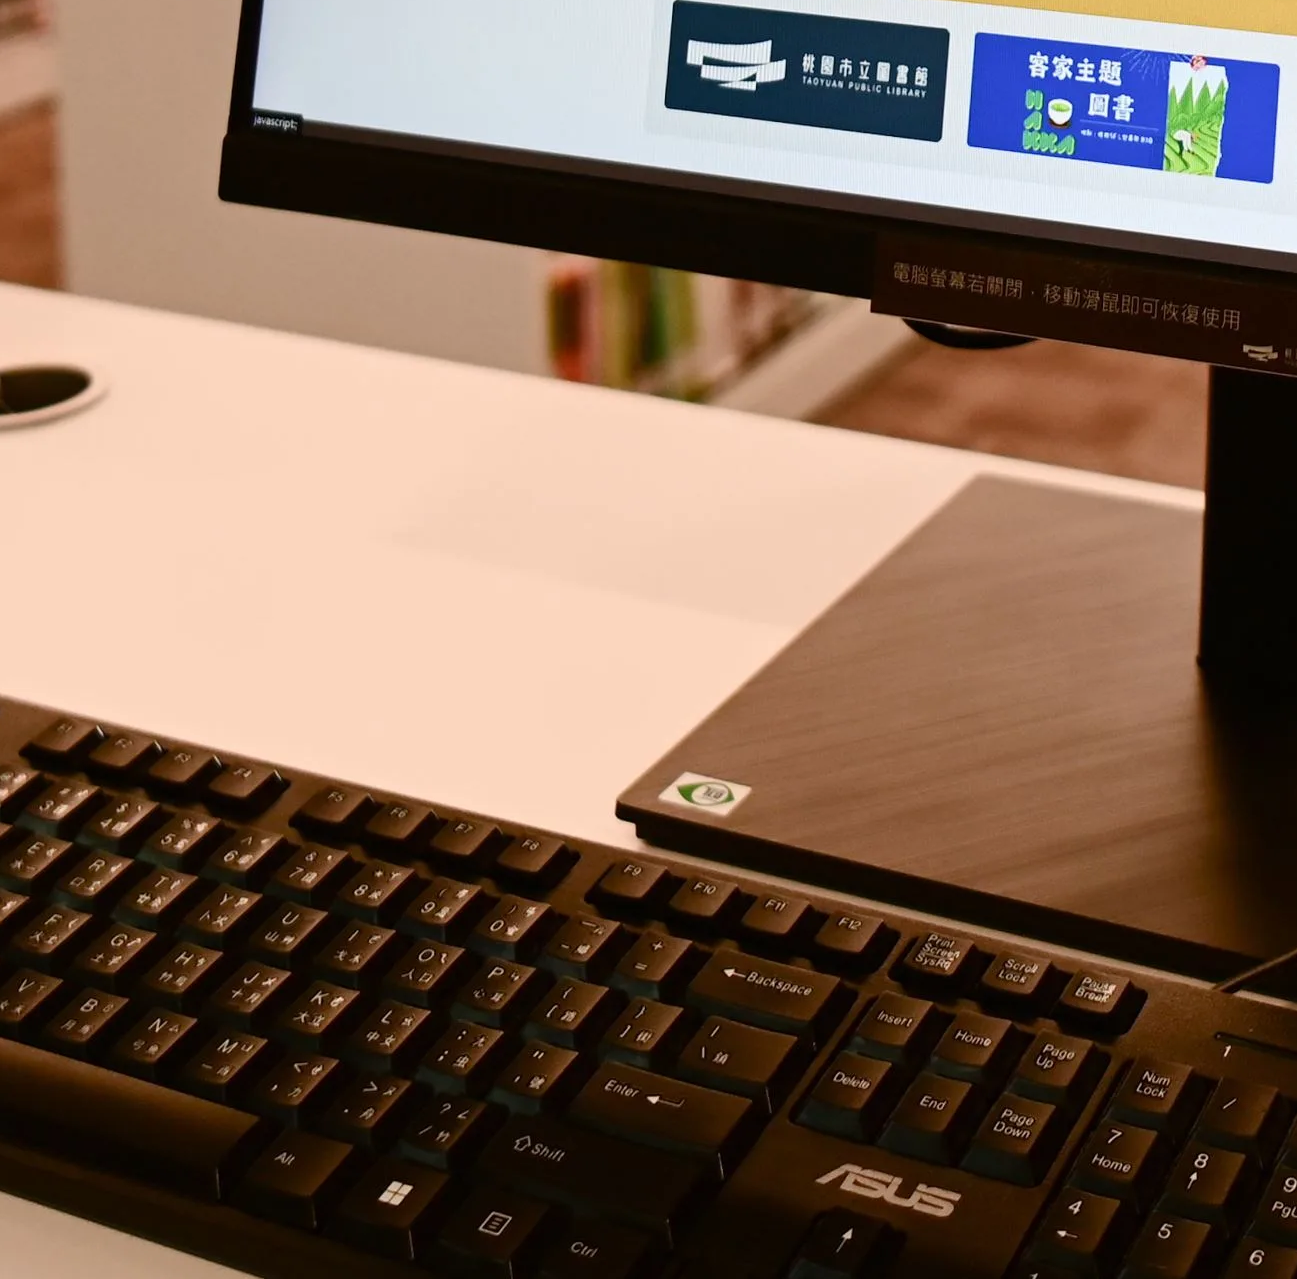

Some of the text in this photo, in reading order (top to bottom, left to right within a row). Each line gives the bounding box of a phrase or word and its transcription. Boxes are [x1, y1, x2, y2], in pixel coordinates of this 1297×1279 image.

[1028, 51, 1123, 87] 客家主題
[803, 76, 927, 98] TAOYUAN PUBLIC LIBRARY
[1088, 92, 1135, 122] 圖書
[327, 791, 345, 803] F5
[390, 806, 408, 819] F6
[455, 822, 473, 835] F7
[160, 833, 176, 846] 5
[521, 838, 540, 852] F8
[26, 841, 45, 855] E
[223, 849, 239, 864] 6
[88, 858, 107, 872] R
[289, 866, 305, 879] 7
[623, 864, 642, 877] F9
[155, 875, 171, 888] T
[693, 881, 717, 896] F10
[353, 884, 369, 897] 8
[219, 892, 235, 906] Y
[765, 898, 787, 913] F11
[420, 901, 436, 914] 9
[44, 913, 63, 926] F
[281, 911, 300, 926] U
[489, 919, 505, 932] 0
[838, 916, 862, 931] F12
[110, 933, 129, 947] G
[651, 940, 665, 952] +
[927, 933, 956, 949] Print
[174, 951, 195, 966] H
[634, 962, 648, 971] =
[915, 952, 953, 971] SysRq
[1004, 958, 1039, 975] Scroll
[243, 971, 261, 986] J
[487, 966, 505, 980] P
[998, 969, 1027, 984] Lock
[17, 977, 36, 994] V
[745, 971, 814, 997] Backspace
[1081, 977, 1117, 993] Pause
[309, 989, 329, 1006] K
[1075, 987, 1111, 1004] Break
[80, 996, 99, 1014] B
[380, 1009, 393, 1025] L
[877, 1010, 914, 1028] Insert
[147, 1017, 169, 1034] N
[216, 1038, 239, 1055] M
[954, 1029, 992, 1048] Home
[1042, 1043, 1075, 1061] Page
[293, 1061, 309, 1074] <
[1035, 1055, 1054, 1070] Up
[362, 1080, 379, 1093] >
[832, 1071, 871, 1091] Delete
[1141, 1070, 1172, 1088] Num
[603, 1078, 640, 1099] Enter
[1136, 1082, 1166, 1100] Lock
[439, 1102, 452, 1115] ?
[919, 1095, 948, 1112] End
[1222, 1096, 1238, 1110] /
[1000, 1108, 1035, 1127] Page
[993, 1120, 1031, 1140] Down
[1107, 1129, 1123, 1147] 7
[274, 1150, 296, 1167] Alt
[530, 1142, 566, 1163] Shift
[1091, 1153, 1132, 1175] Home
[1194, 1153, 1210, 1171] 8
[815, 1163, 962, 1218] ASUS
[1282, 1177, 1297, 1195] 9
[1067, 1199, 1083, 1216] 4
[1157, 1222, 1172, 1241] 5
[570, 1240, 598, 1259] Ctrl
[1248, 1248, 1264, 1267] 6
